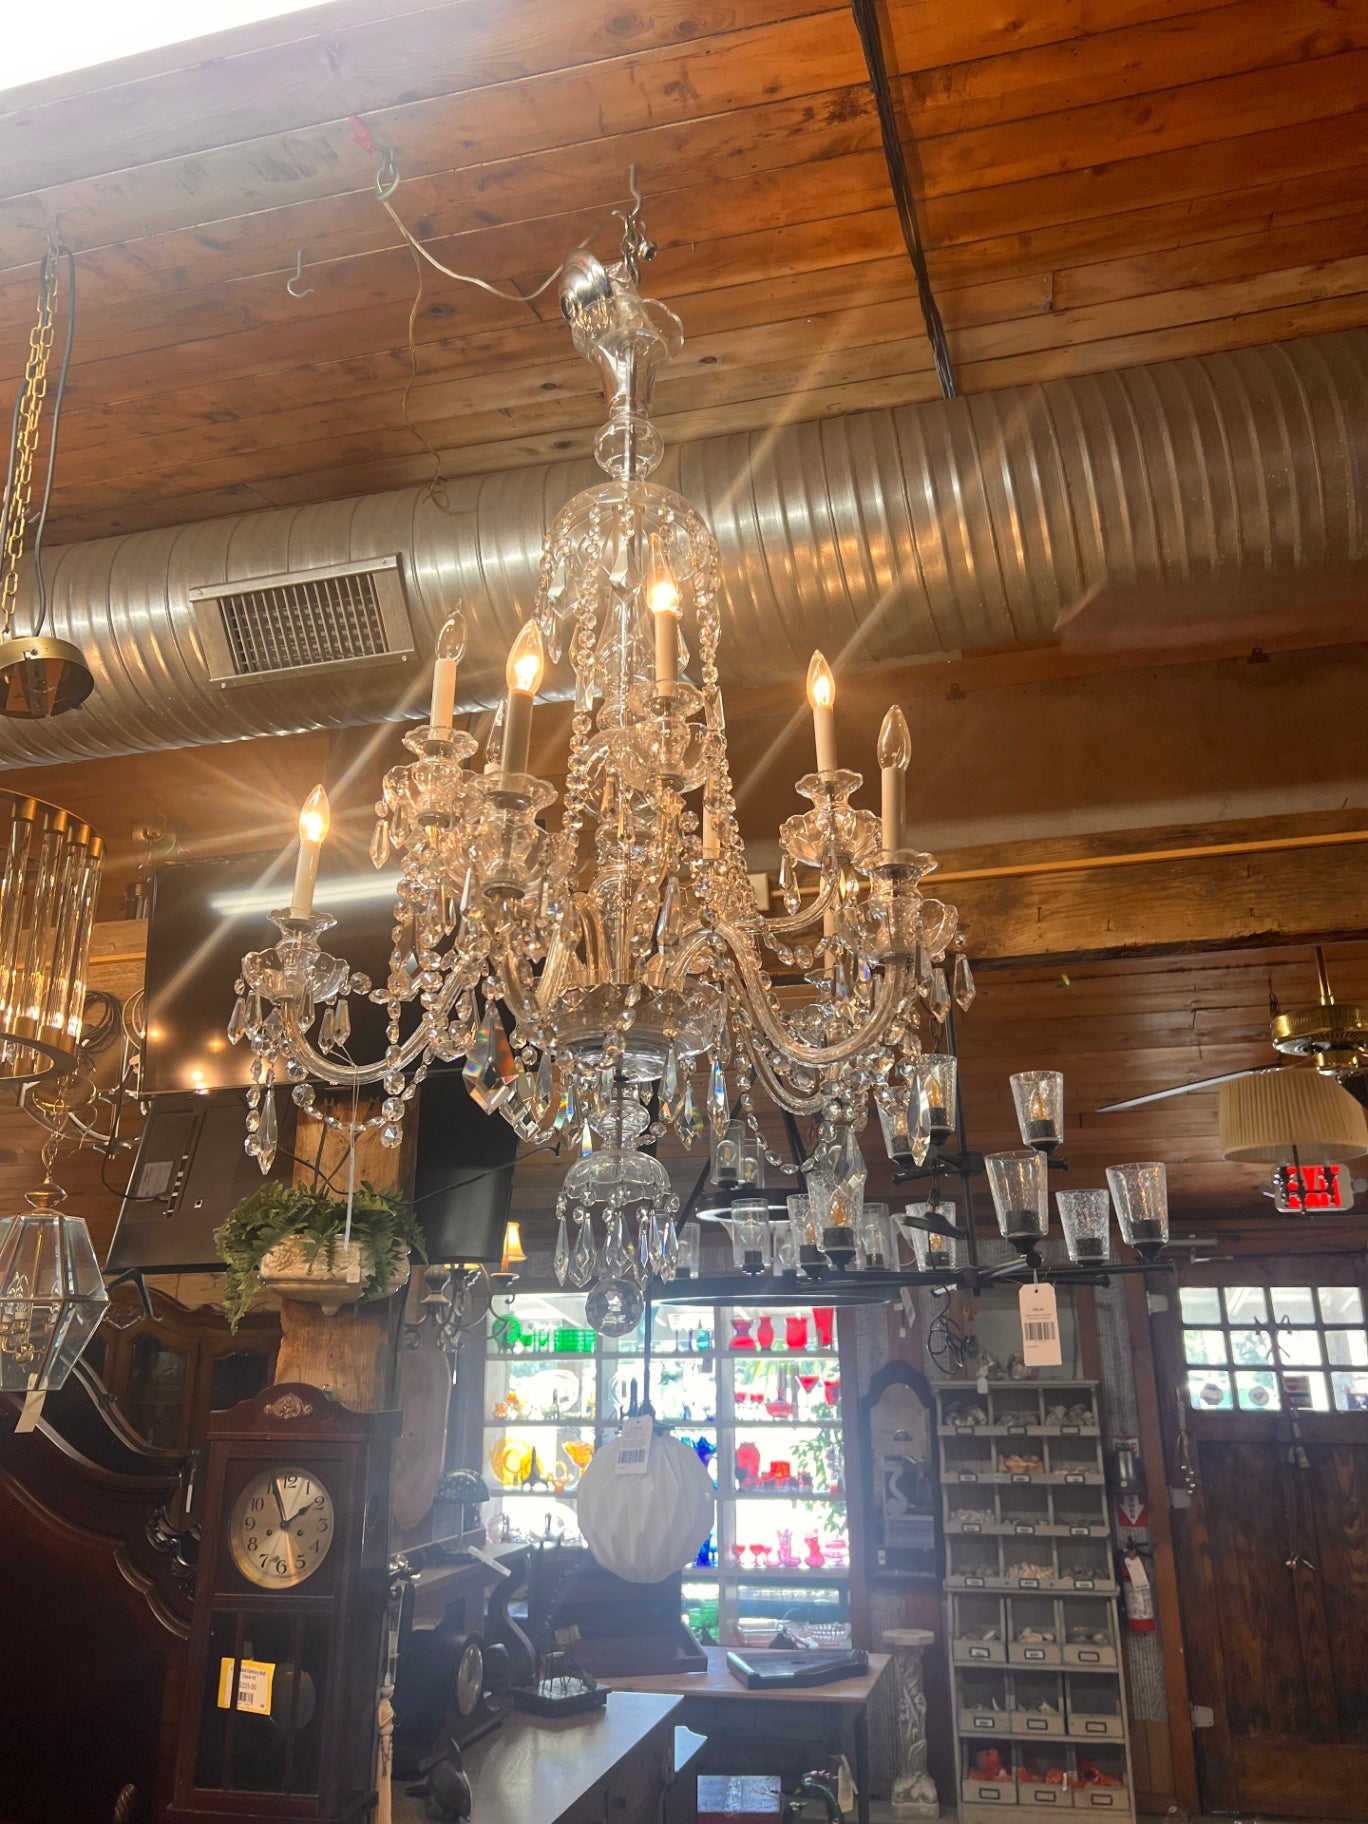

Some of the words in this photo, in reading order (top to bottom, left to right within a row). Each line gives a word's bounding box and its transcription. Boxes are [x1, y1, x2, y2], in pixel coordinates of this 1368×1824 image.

[283, 1475, 298, 1488] 12
[306, 1481, 310, 1495] 1
[251, 1497, 264, 1512] 10
[314, 1496, 325, 1510] 2
[245, 1517, 256, 1530] 9
[318, 1518, 328, 1532] 3
[248, 1537, 258, 1551] 8
[309, 1539, 320, 1553] 4
[260, 1554, 270, 1568] 7
[276, 1560, 287, 1574] 6
[296, 1555, 306, 1568] 5
